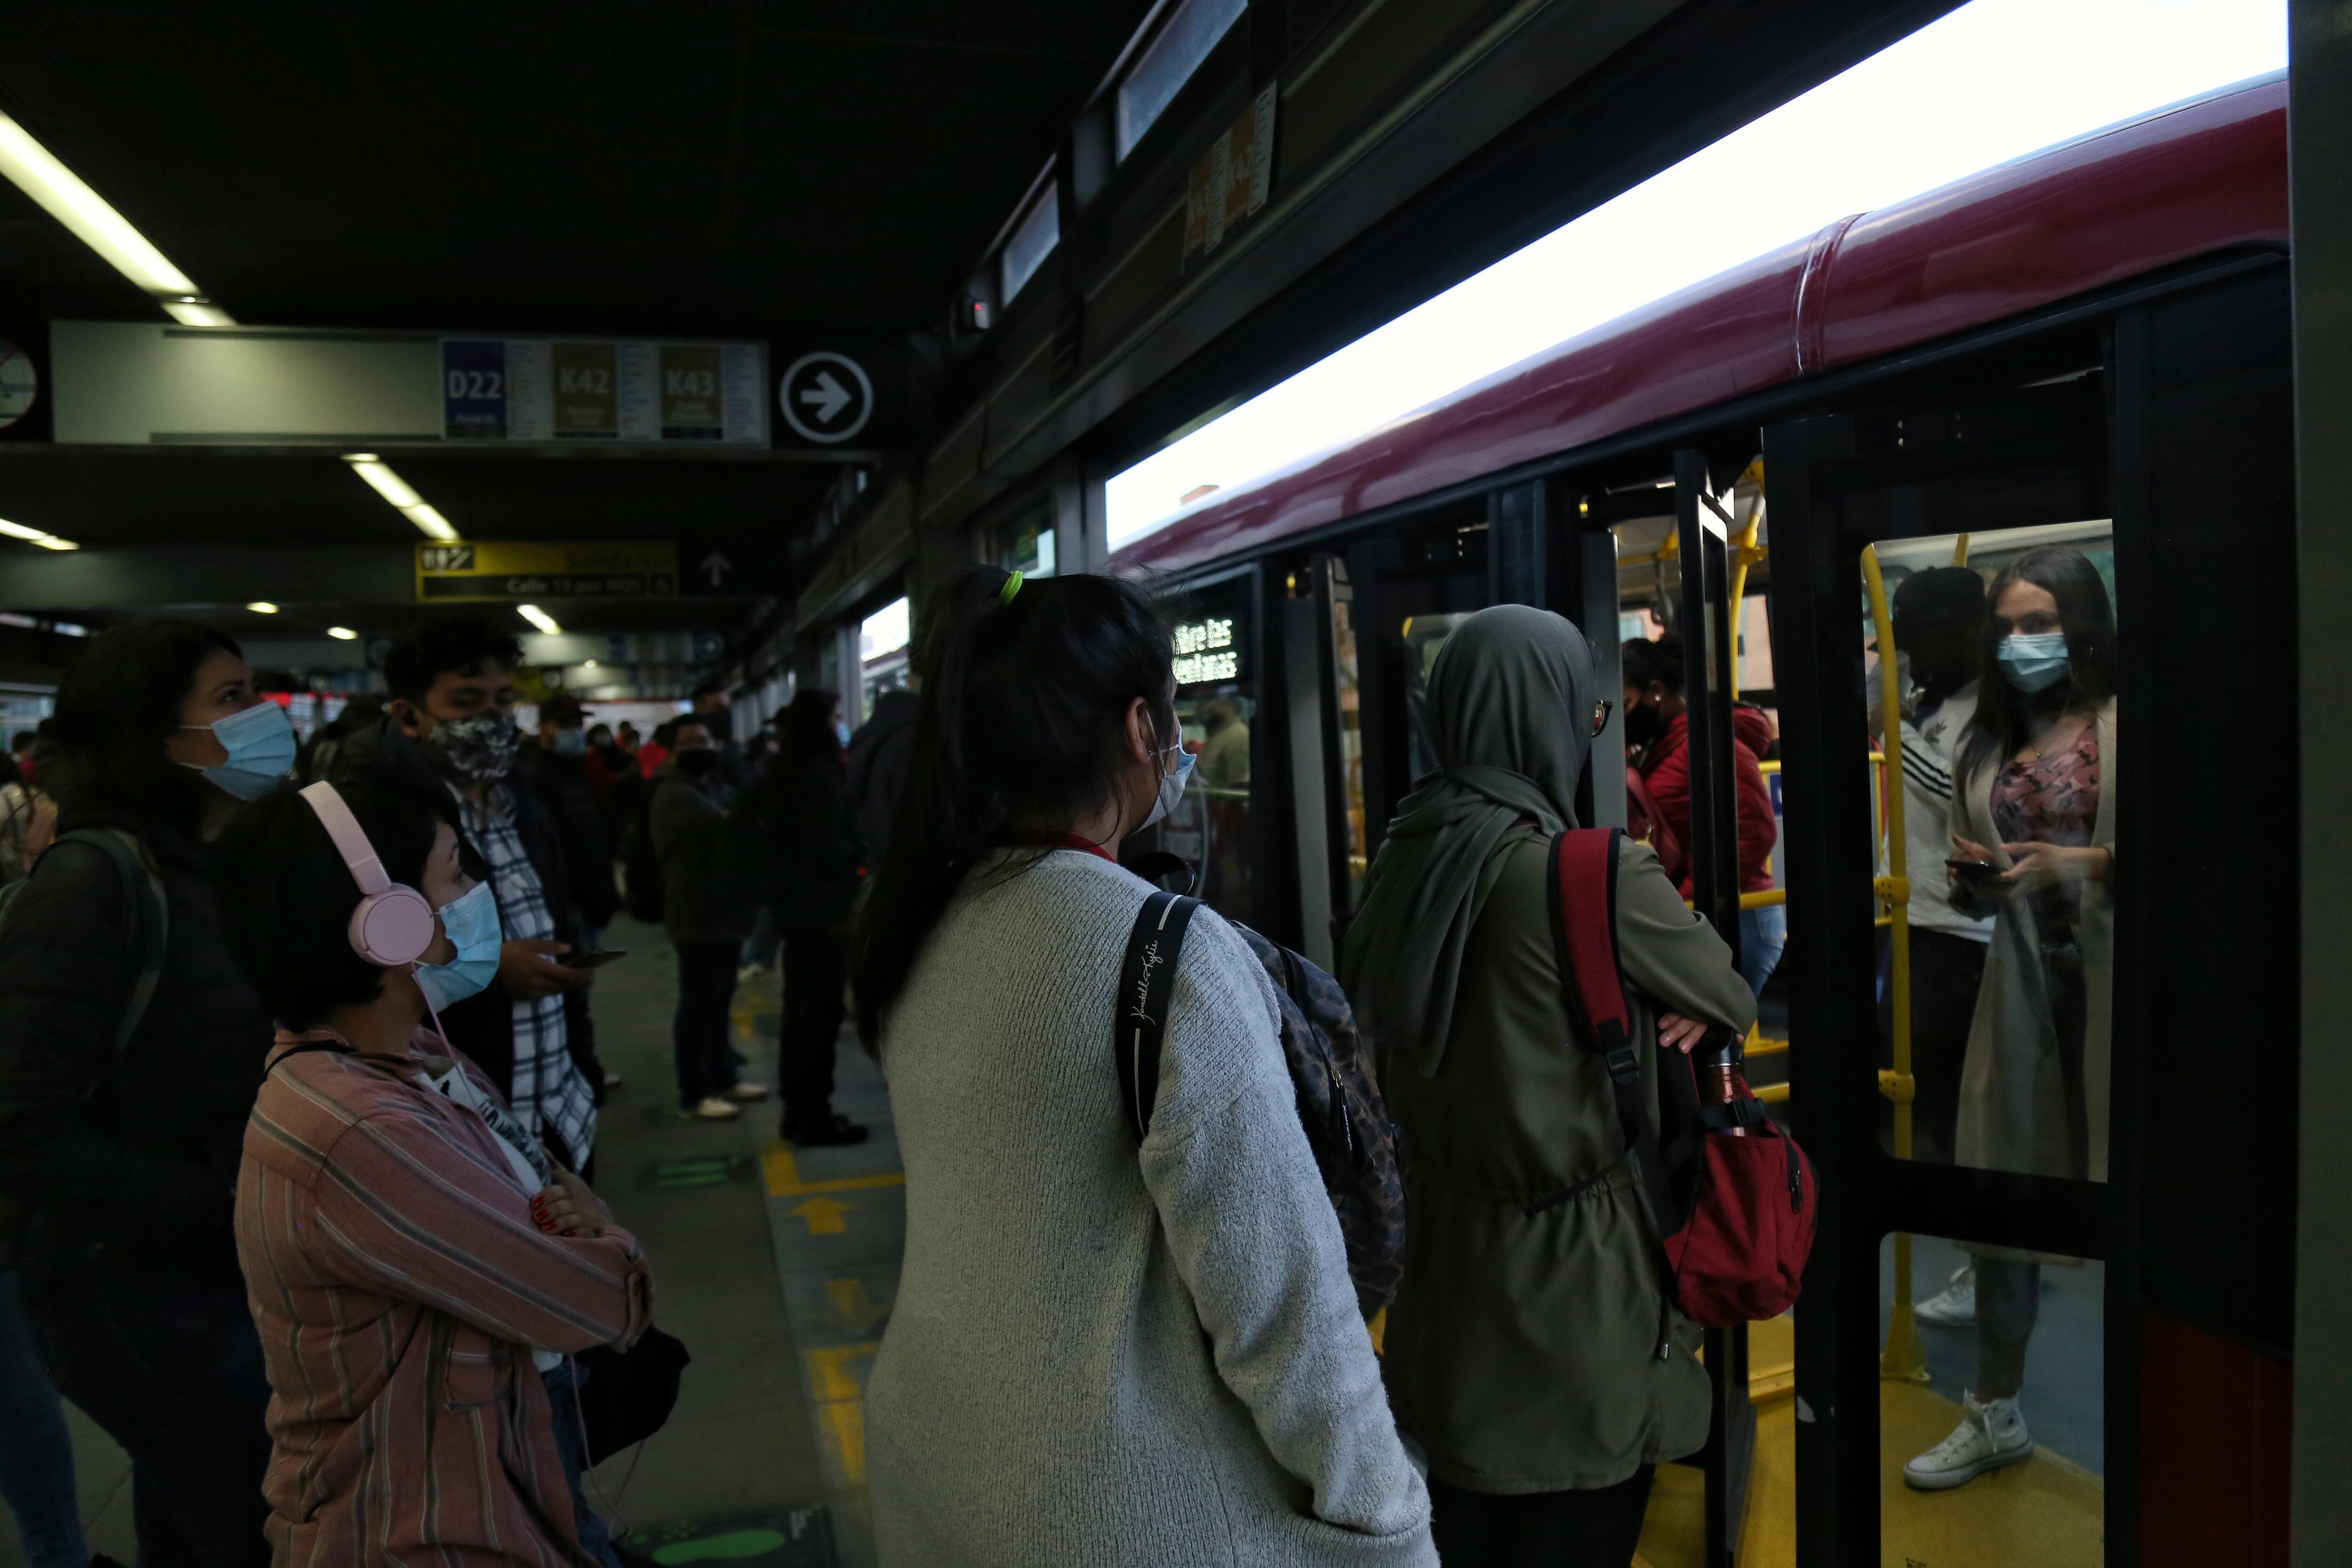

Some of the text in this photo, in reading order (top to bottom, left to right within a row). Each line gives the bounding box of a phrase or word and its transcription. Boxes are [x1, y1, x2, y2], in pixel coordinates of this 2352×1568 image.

[448, 370, 502, 399] D22
[560, 368, 609, 394] K42
[667, 370, 715, 397] K43
[1141, 940, 1163, 981] Kylie
[1130, 981, 1156, 1026] Kendall
